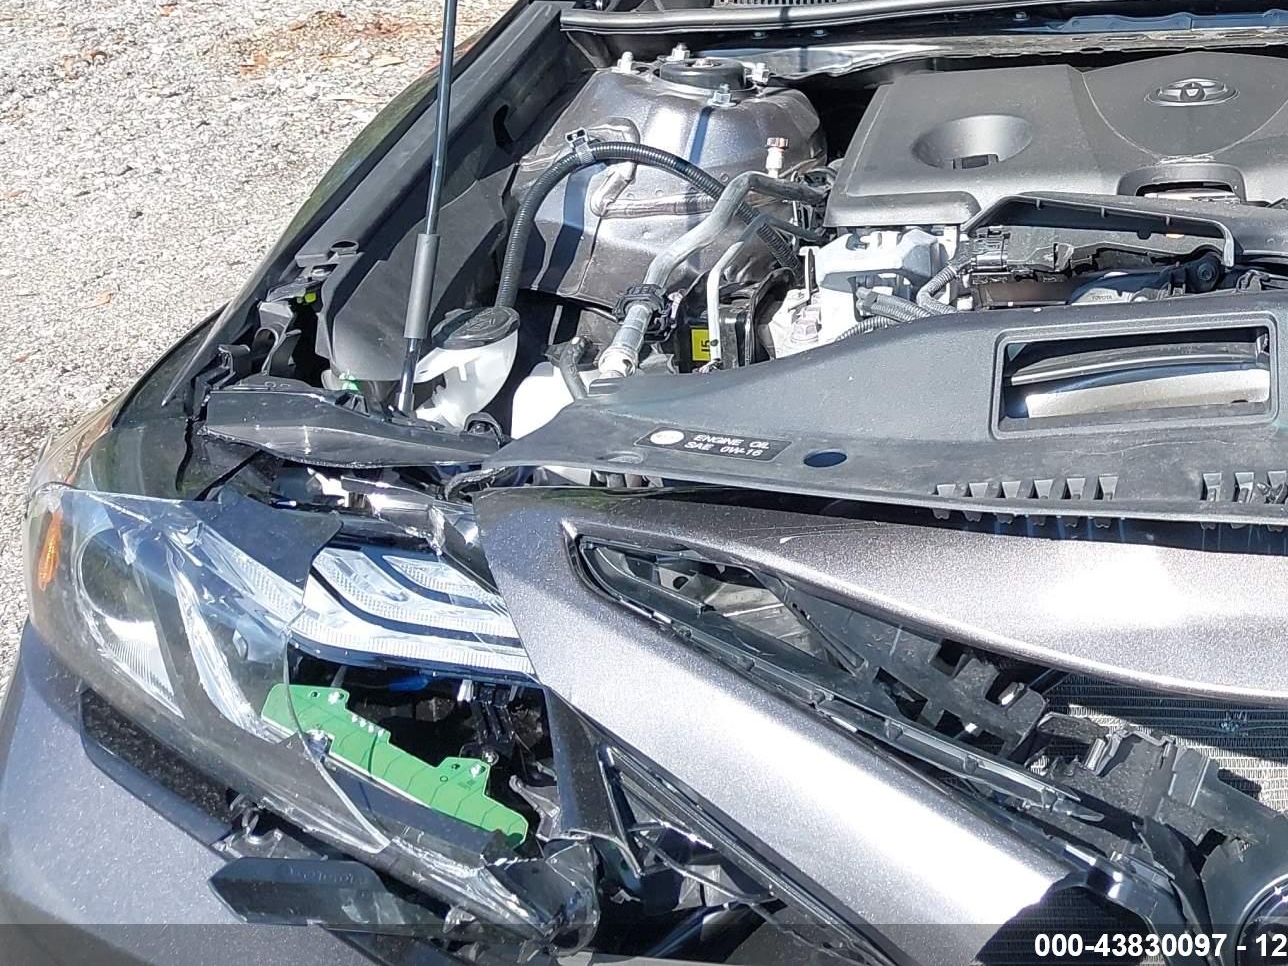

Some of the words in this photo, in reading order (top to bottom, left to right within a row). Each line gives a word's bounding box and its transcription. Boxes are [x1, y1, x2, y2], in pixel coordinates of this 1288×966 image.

[684, 441, 714, 451] SAE
[719, 446, 764, 456] 0W-16
[693, 434, 745, 446] ENGINE
[749, 441, 770, 450] OIL
